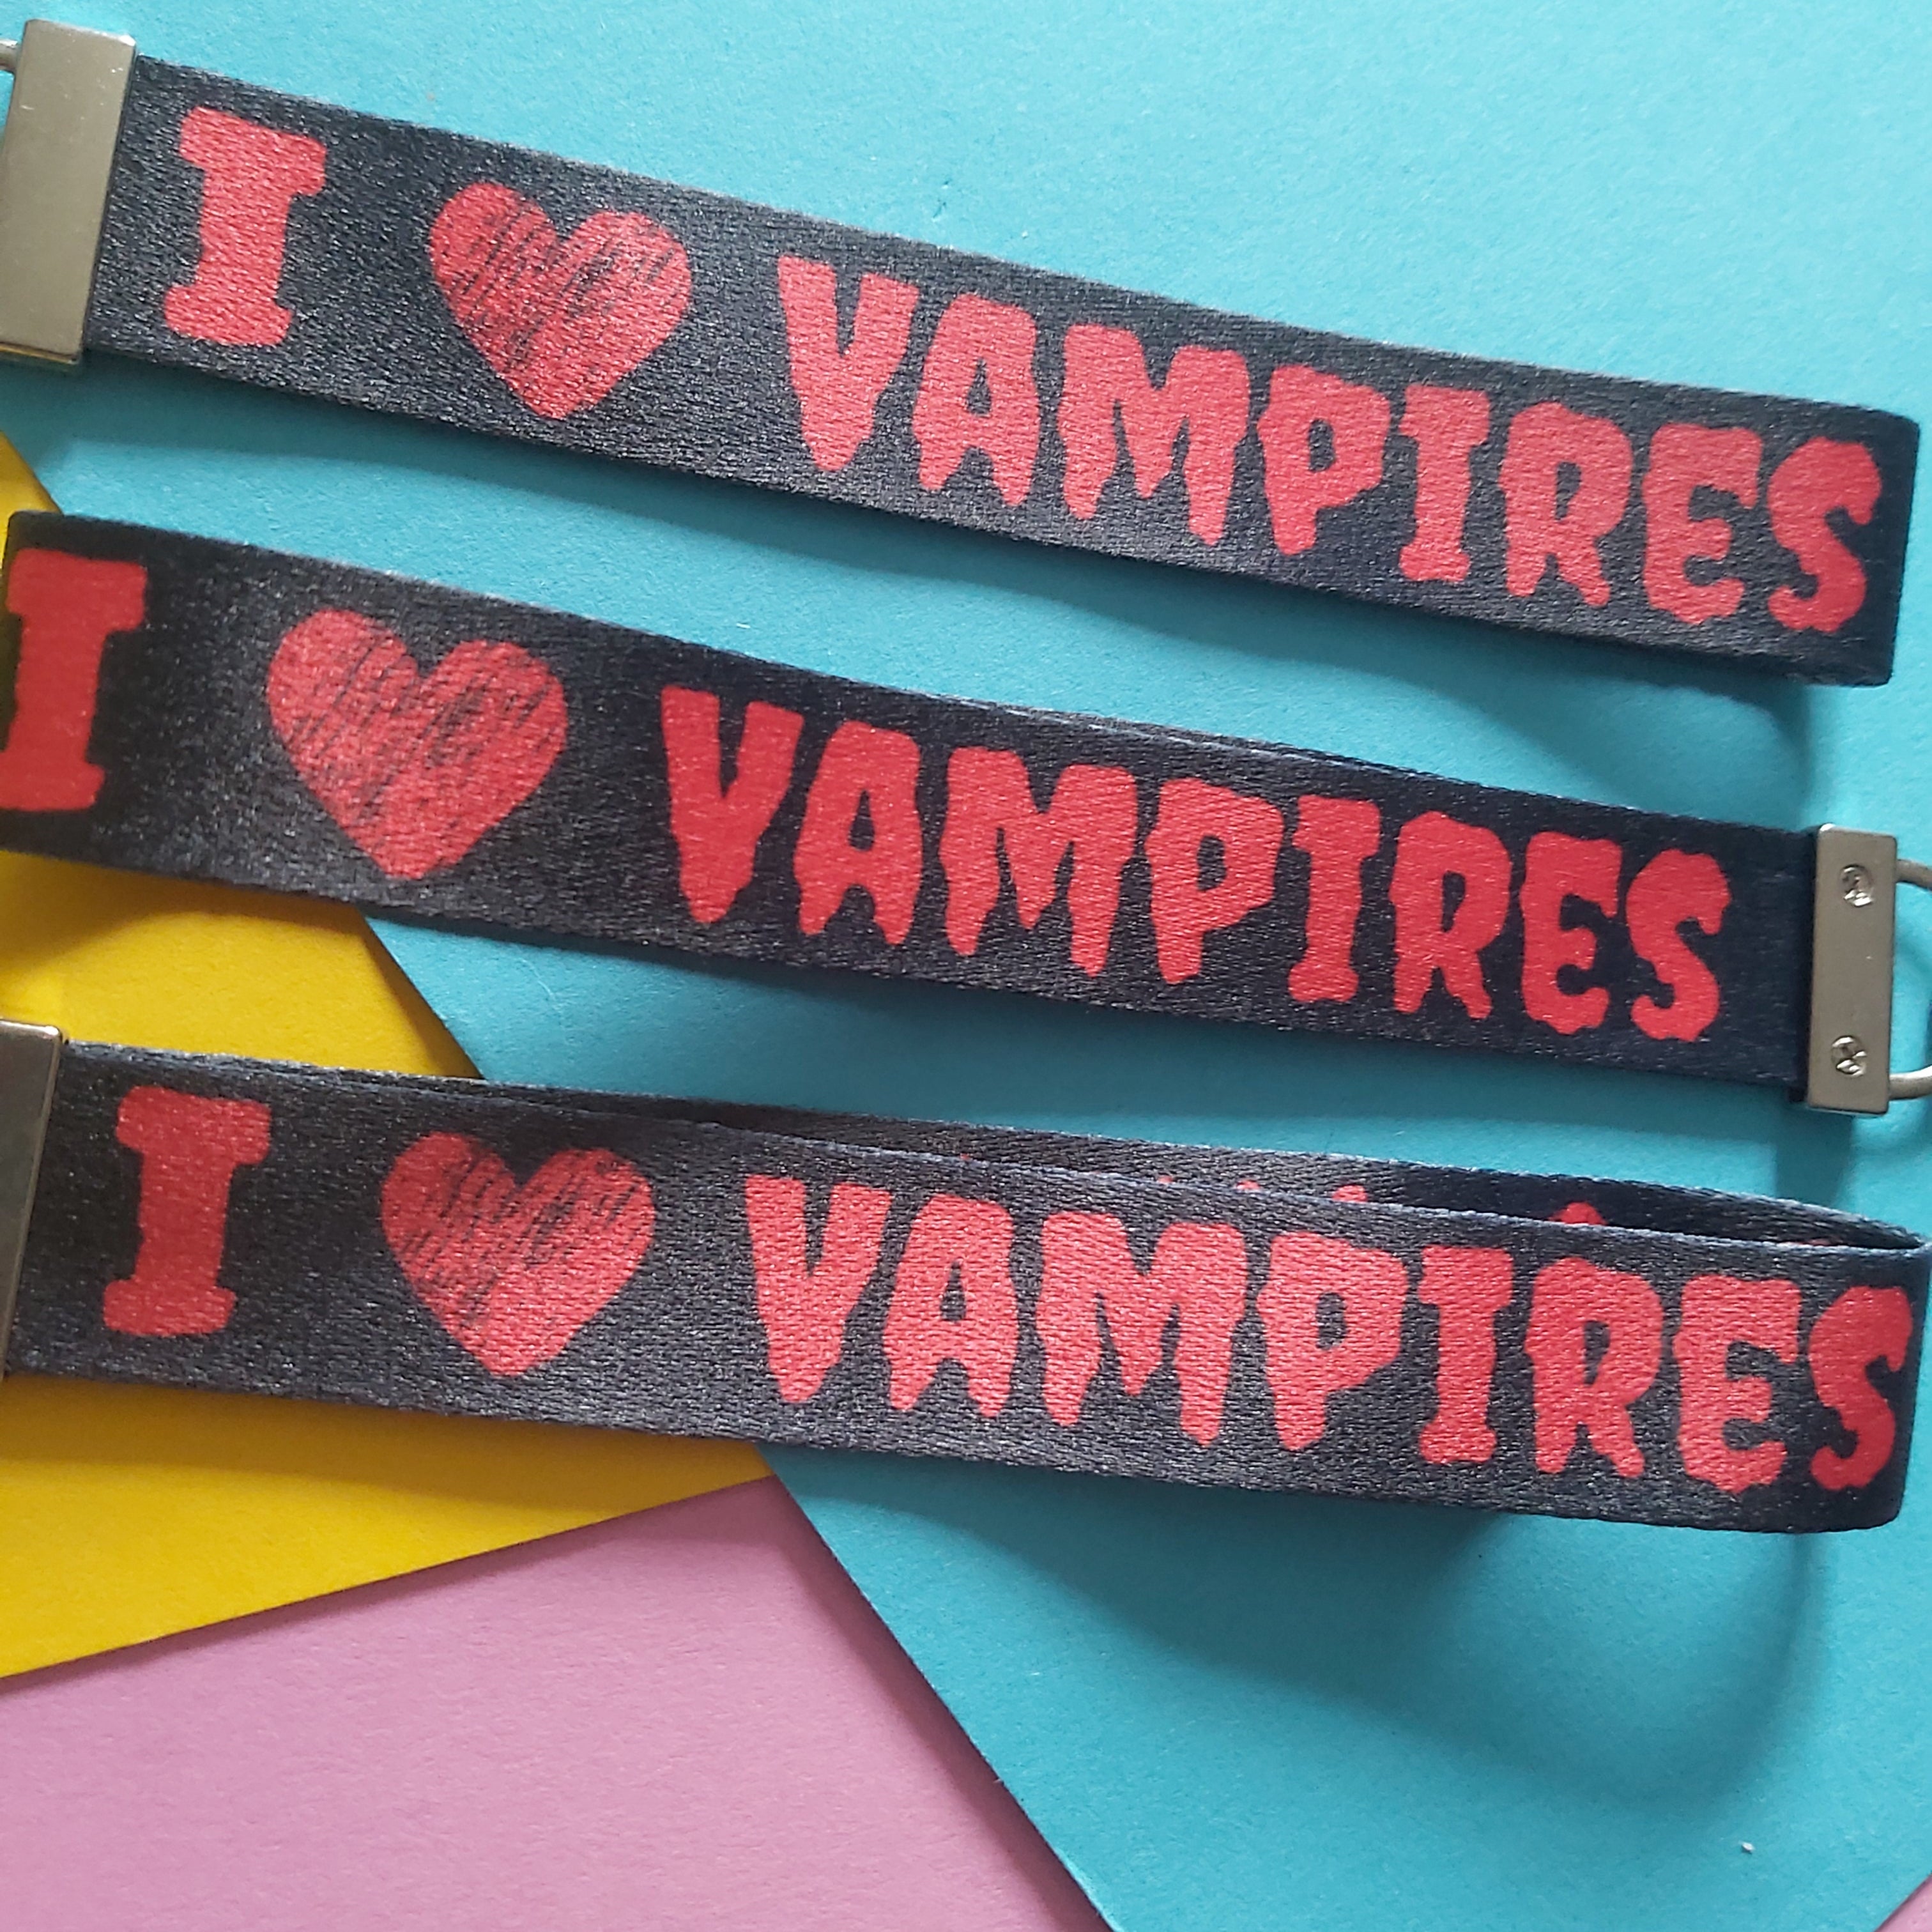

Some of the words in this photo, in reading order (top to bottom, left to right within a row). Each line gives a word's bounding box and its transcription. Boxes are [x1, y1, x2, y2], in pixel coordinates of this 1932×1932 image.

[164, 107, 326, 347] I
[778, 256, 1881, 632] VAMPIRES
[0, 548, 147, 812] I
[661, 686, 1731, 1043] VAMPIRES
[103, 1086, 271, 1337] I
[744, 1174, 1912, 1494] VAMPIRES
